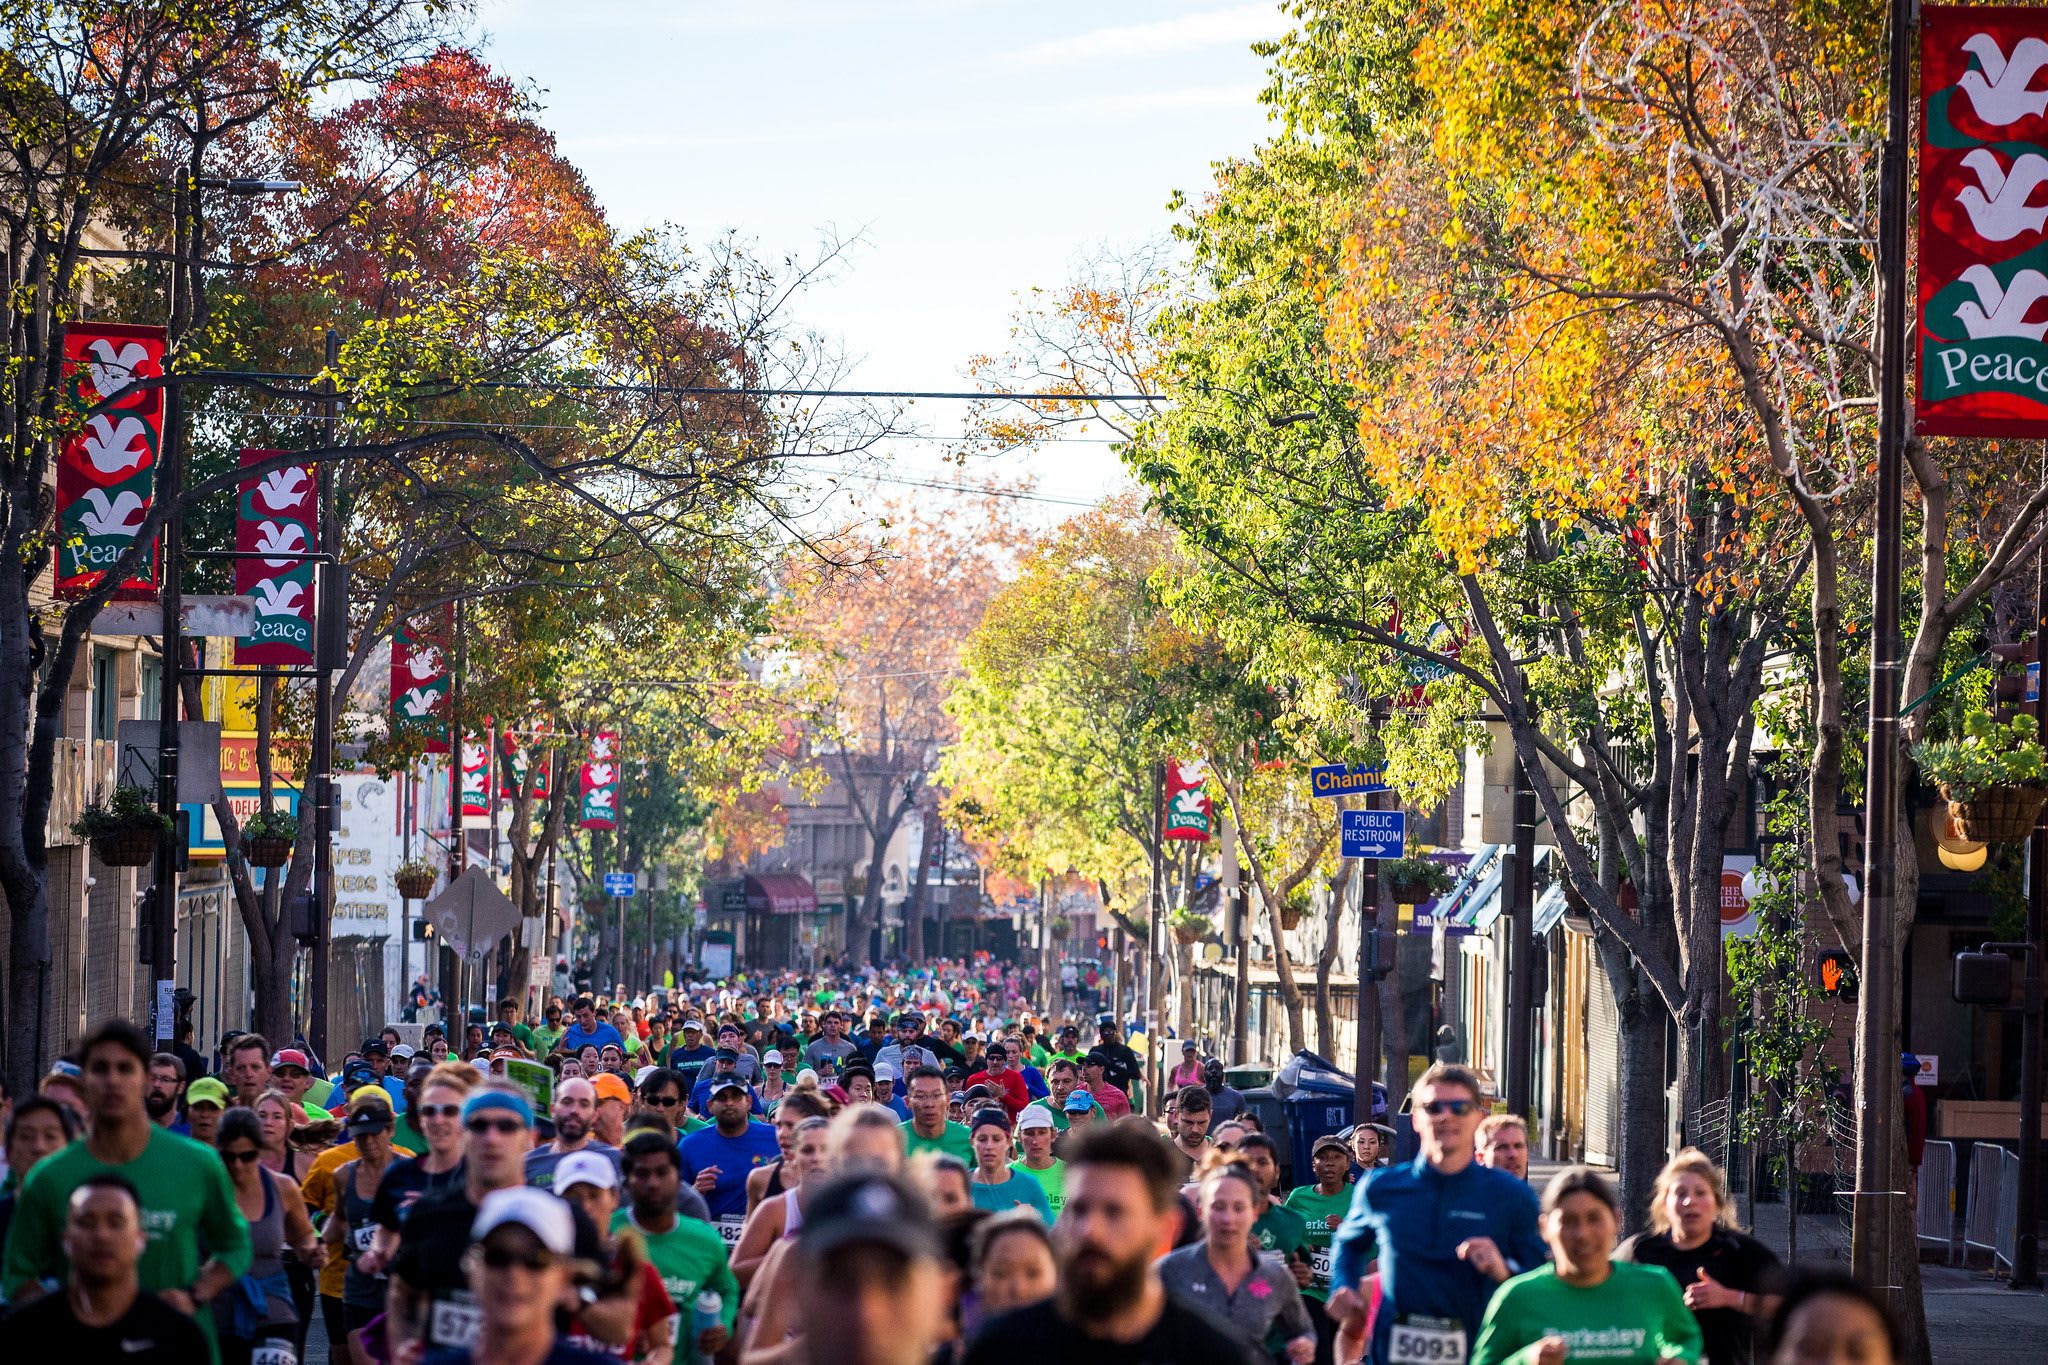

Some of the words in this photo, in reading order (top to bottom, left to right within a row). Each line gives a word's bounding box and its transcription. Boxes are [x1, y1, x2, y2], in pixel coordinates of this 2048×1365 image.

[1171, 813, 1207, 828] Peace
[1355, 815, 1392, 827] PUBLIC
[1344, 829, 1401, 842] RESTROOM
[1398, 1334, 1460, 1360] 5093
